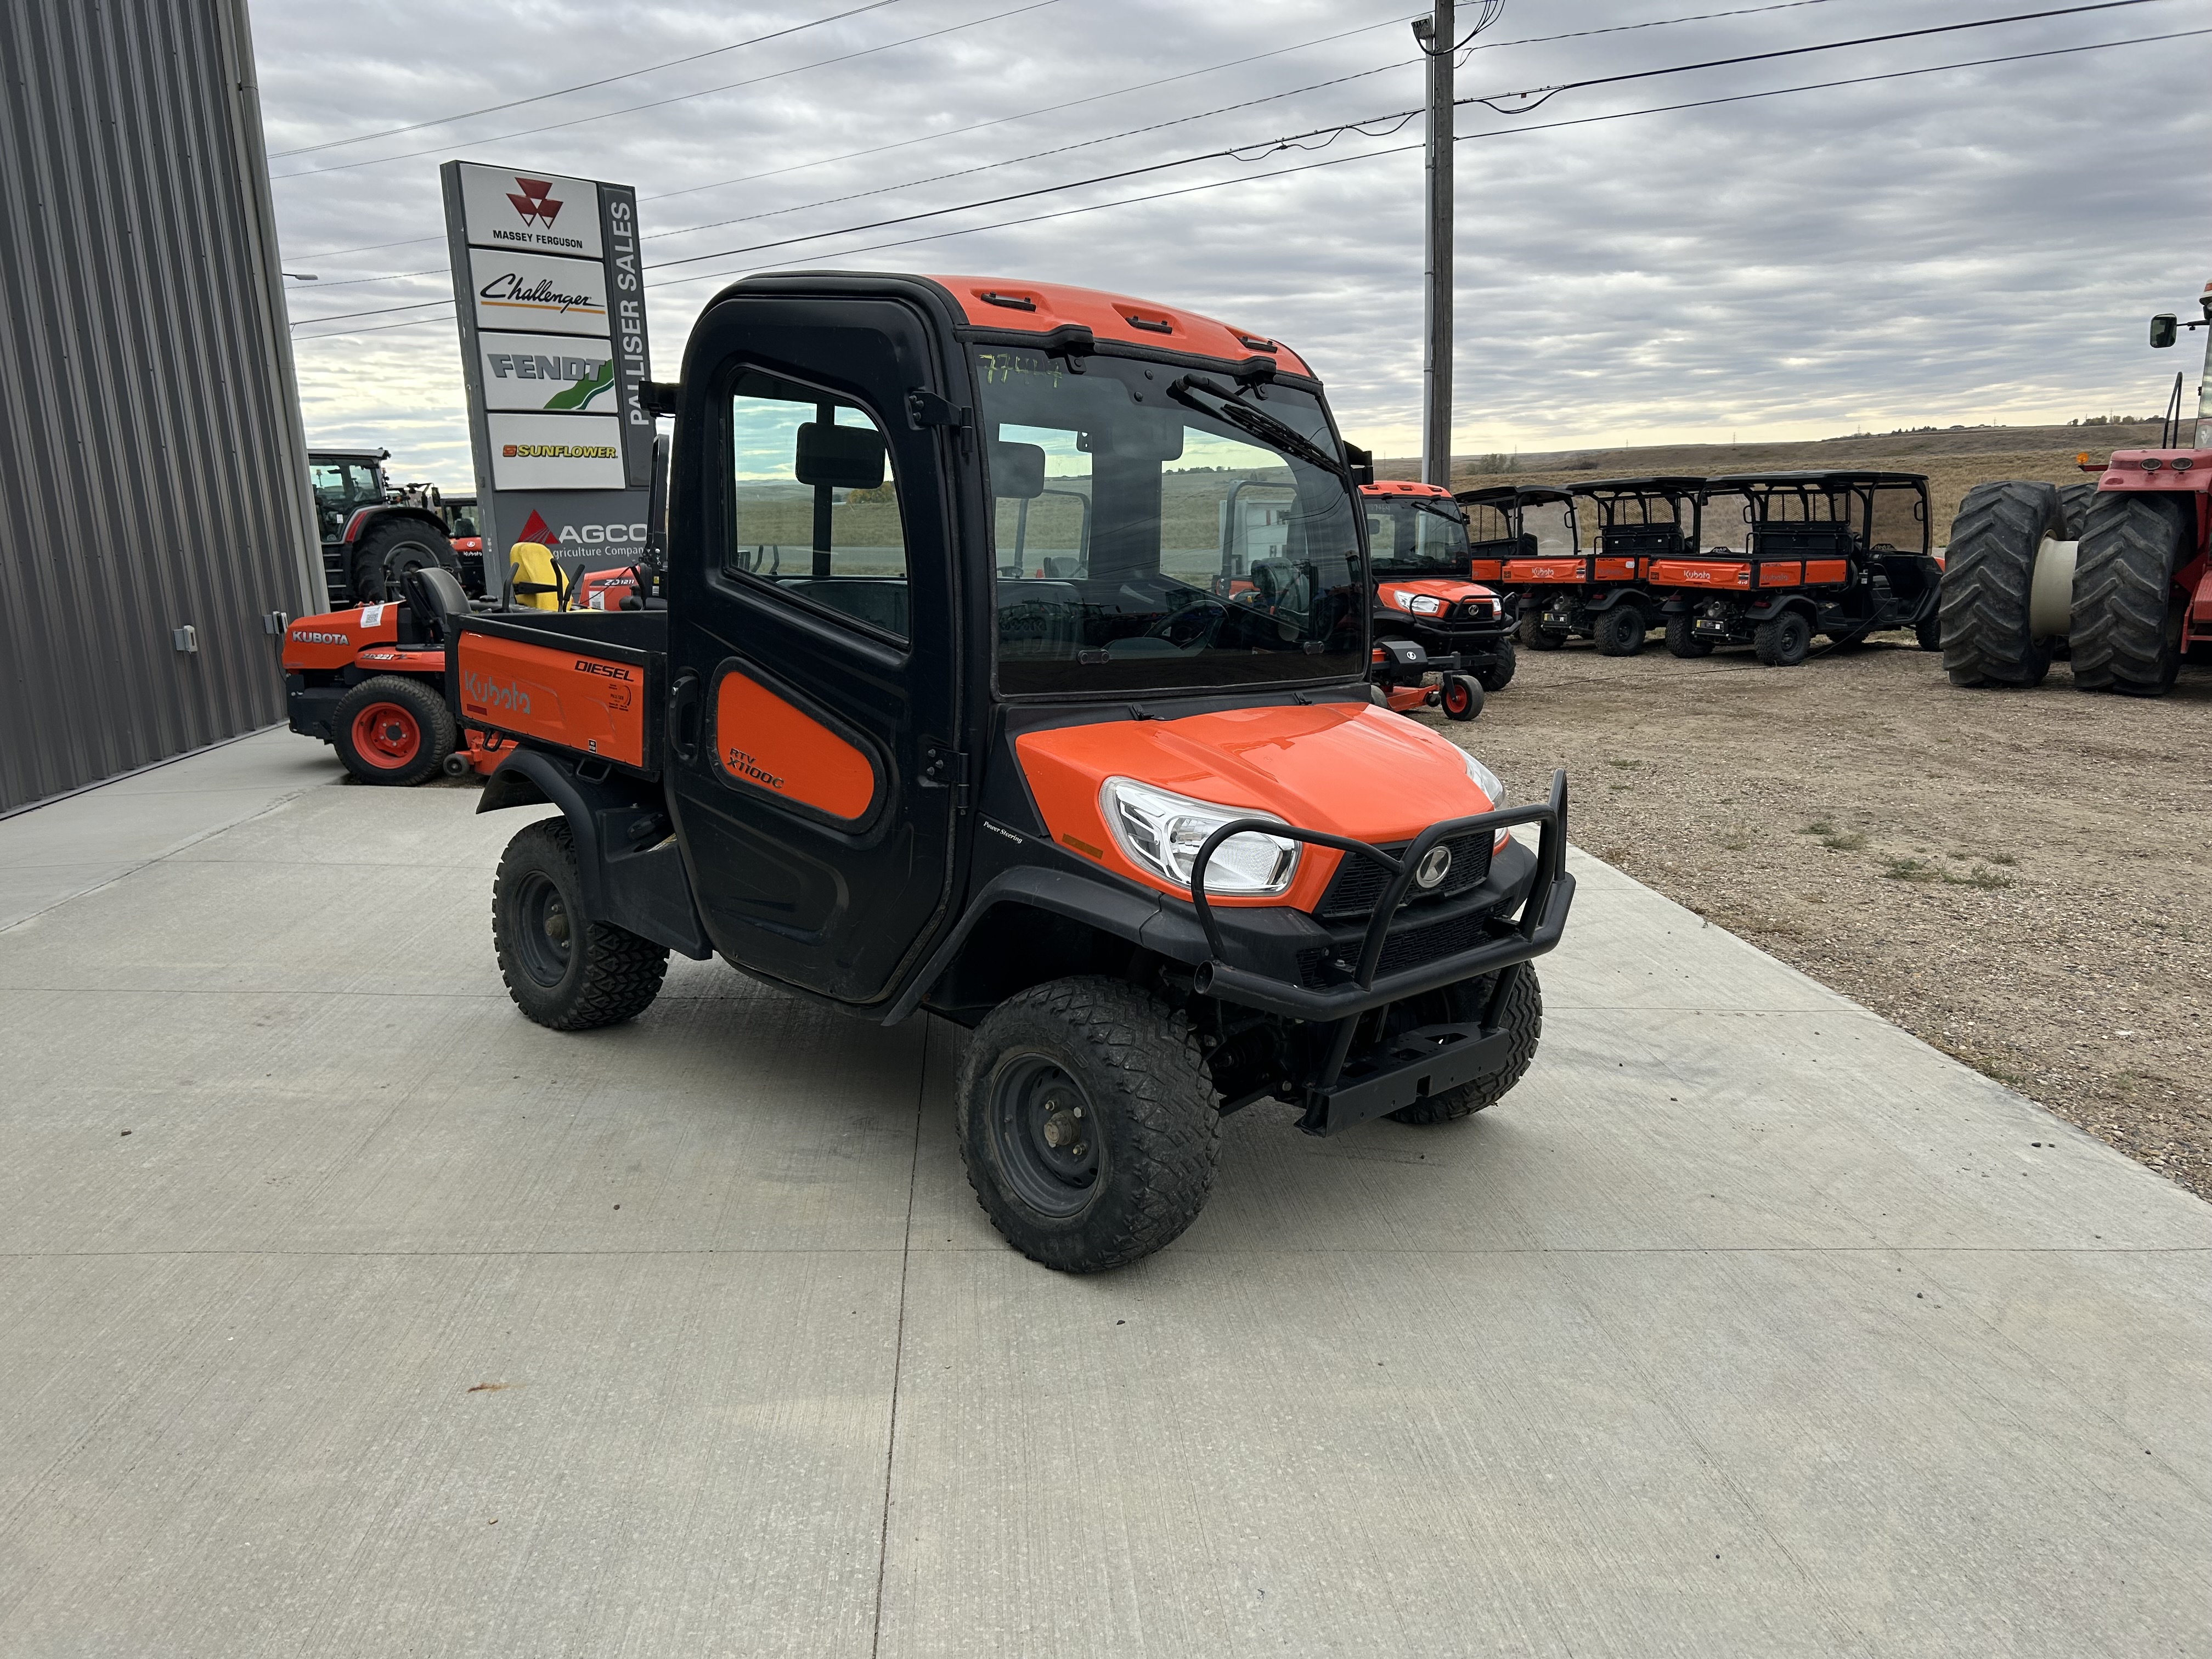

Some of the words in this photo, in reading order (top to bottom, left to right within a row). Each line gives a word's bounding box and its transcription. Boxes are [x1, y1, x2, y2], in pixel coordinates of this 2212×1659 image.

[493, 230, 533, 242] MASSEY
[536, 235, 583, 249] FERGUSON
[611, 201, 637, 291] SALES
[480, 273, 605, 314] Challenger
[487, 354, 606, 381] FENDT
[517, 445, 616, 458] SUNFLOWER
[558, 523, 647, 544] AGCO
[552, 546, 602, 560] griculture
[605, 546, 644, 557] Compan
[1684, 570, 1711, 579] Kubota
[292, 631, 350, 646] KUBOTA
[574, 660, 634, 682] DIESEL
[465, 670, 531, 715] Kubota
[730, 748, 756, 764] RTV
[727, 755, 785, 788] X1100C
[983, 821, 1001, 832] Power
[1000, 829, 1023, 844] Steering
